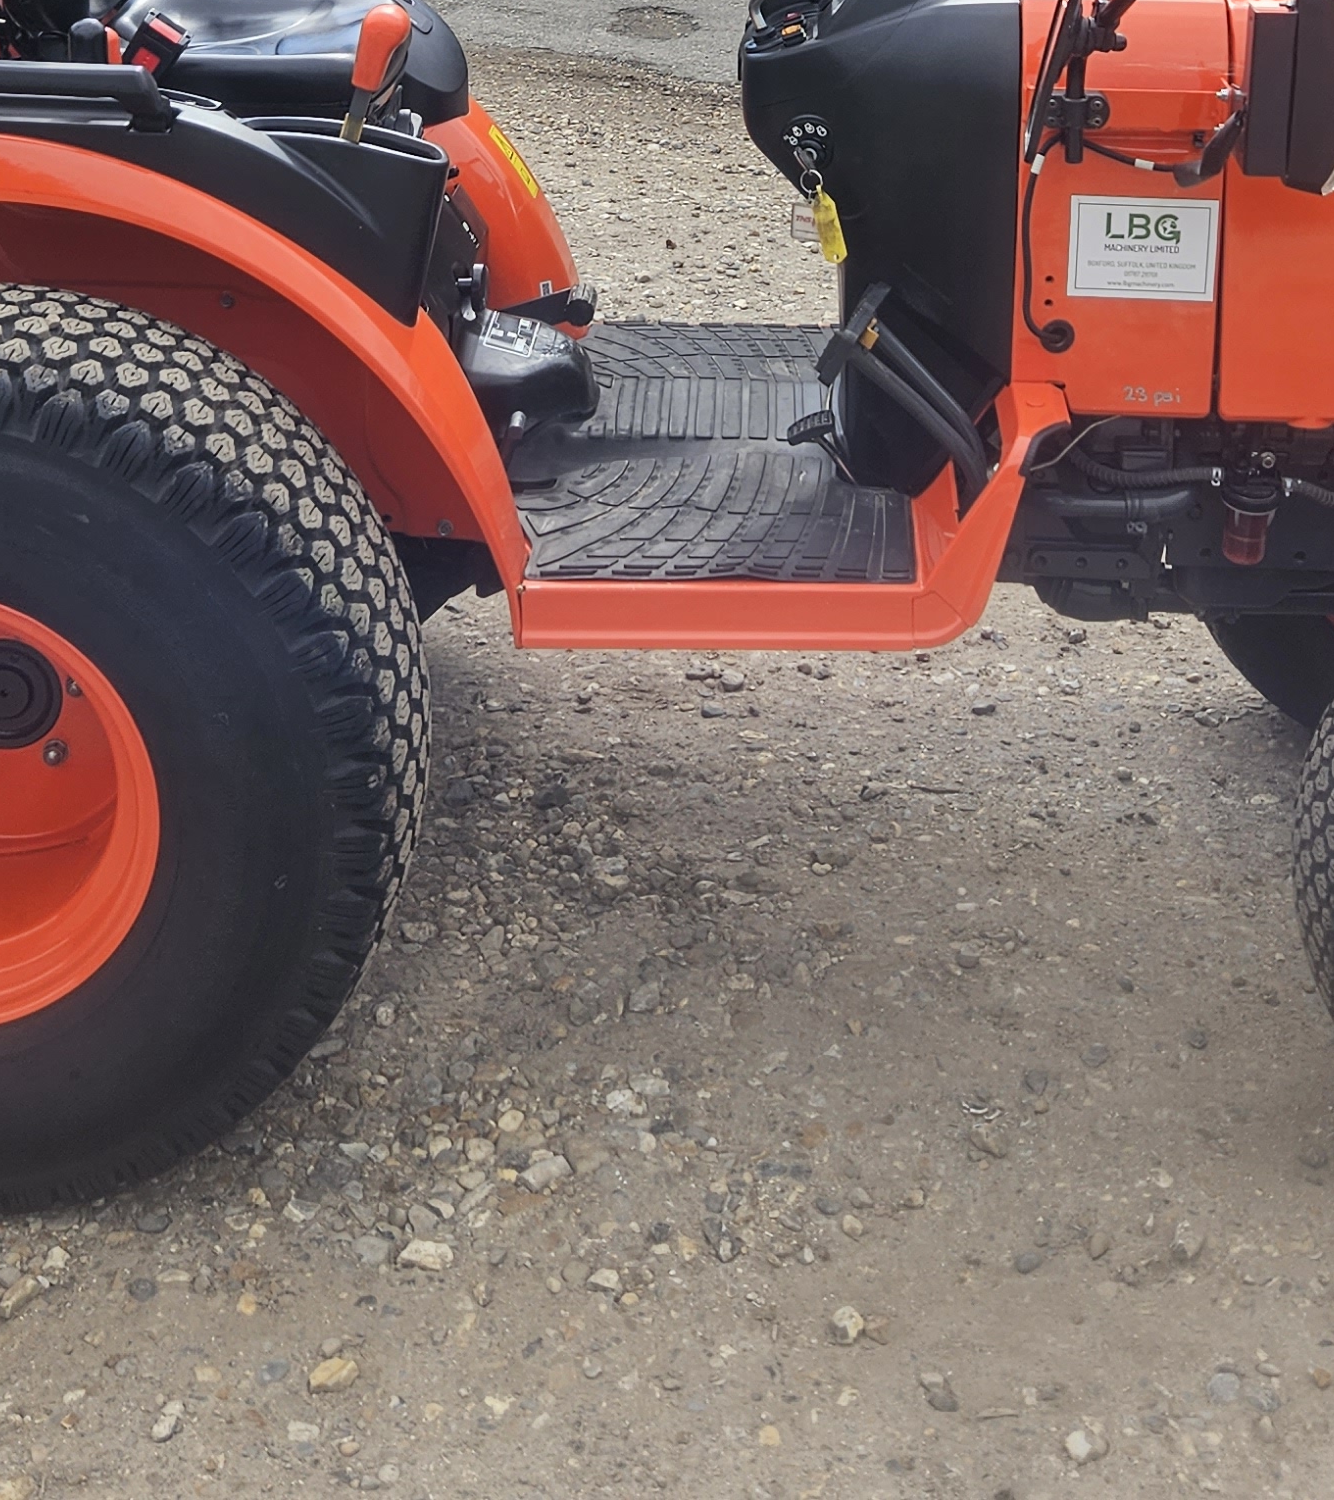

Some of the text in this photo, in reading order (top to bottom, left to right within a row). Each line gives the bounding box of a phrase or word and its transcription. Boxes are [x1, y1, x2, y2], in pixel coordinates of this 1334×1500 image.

[1105, 212, 1181, 245] LBG
[1103, 243, 1180, 254] MACHINERY LIMITED
[1117, 261, 1145, 269] SUFFOLK,
[1145, 261, 1168, 269] UNITED
[1106, 279, 1175, 288] www.lbgmachinery.com
